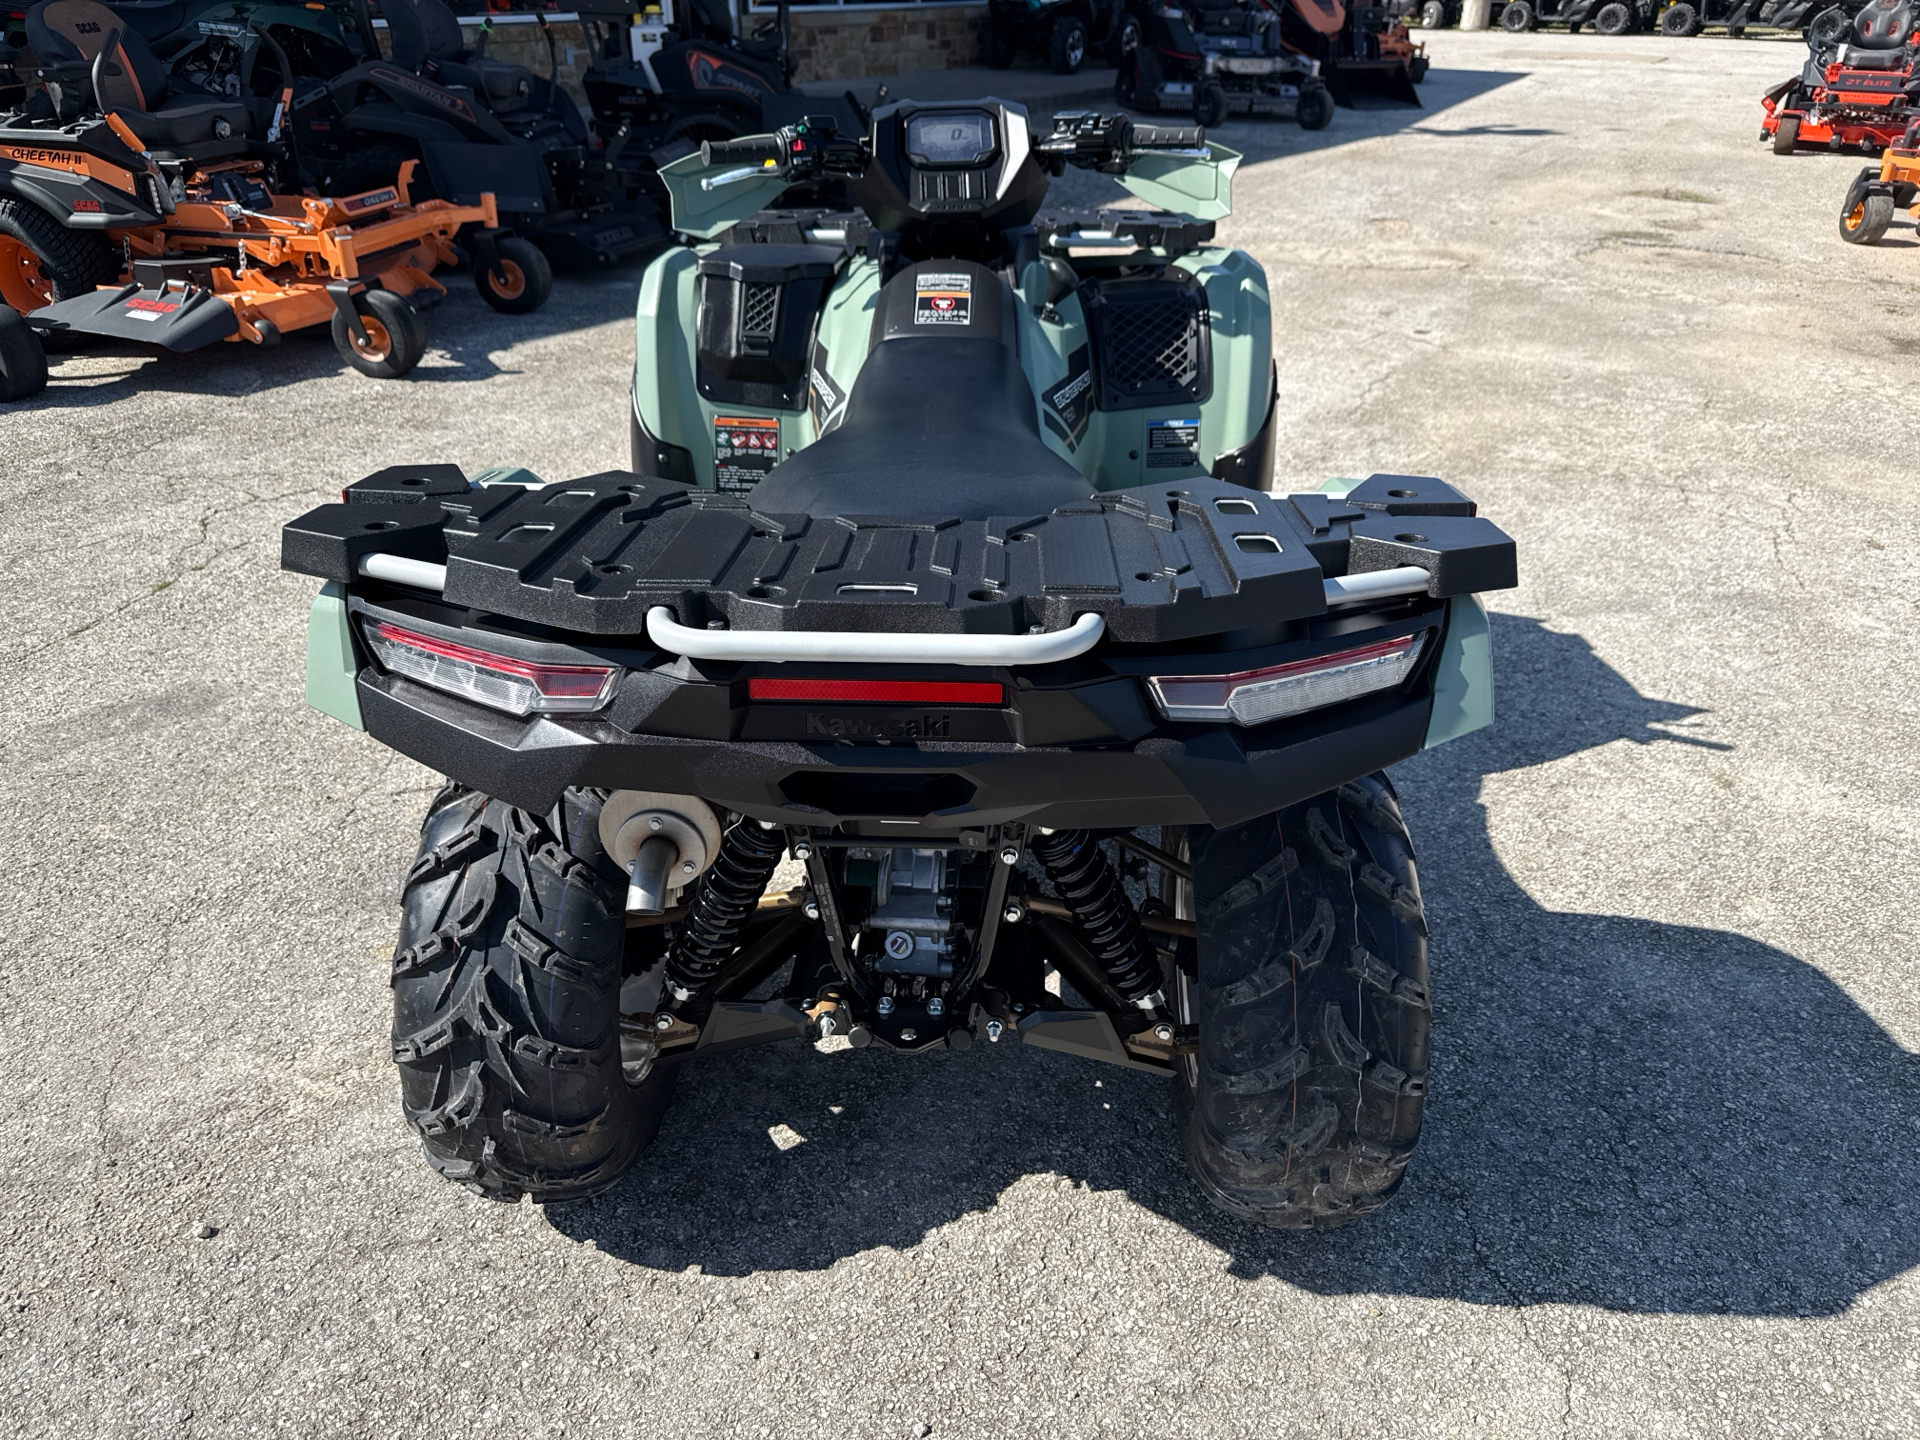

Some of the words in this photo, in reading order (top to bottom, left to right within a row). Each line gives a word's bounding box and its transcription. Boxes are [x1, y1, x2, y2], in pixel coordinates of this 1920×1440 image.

[75, 22, 101, 34] SCAG
[397, 77, 451, 105] SPARTAN
[951, 128, 963, 140] 0
[12, 148, 71, 164] CHEETAH
[74, 155, 82, 165] II
[72, 200, 100, 211] SCAG
[125, 298, 179, 313] SCAG
[805, 712, 950, 737] Kawasaki
